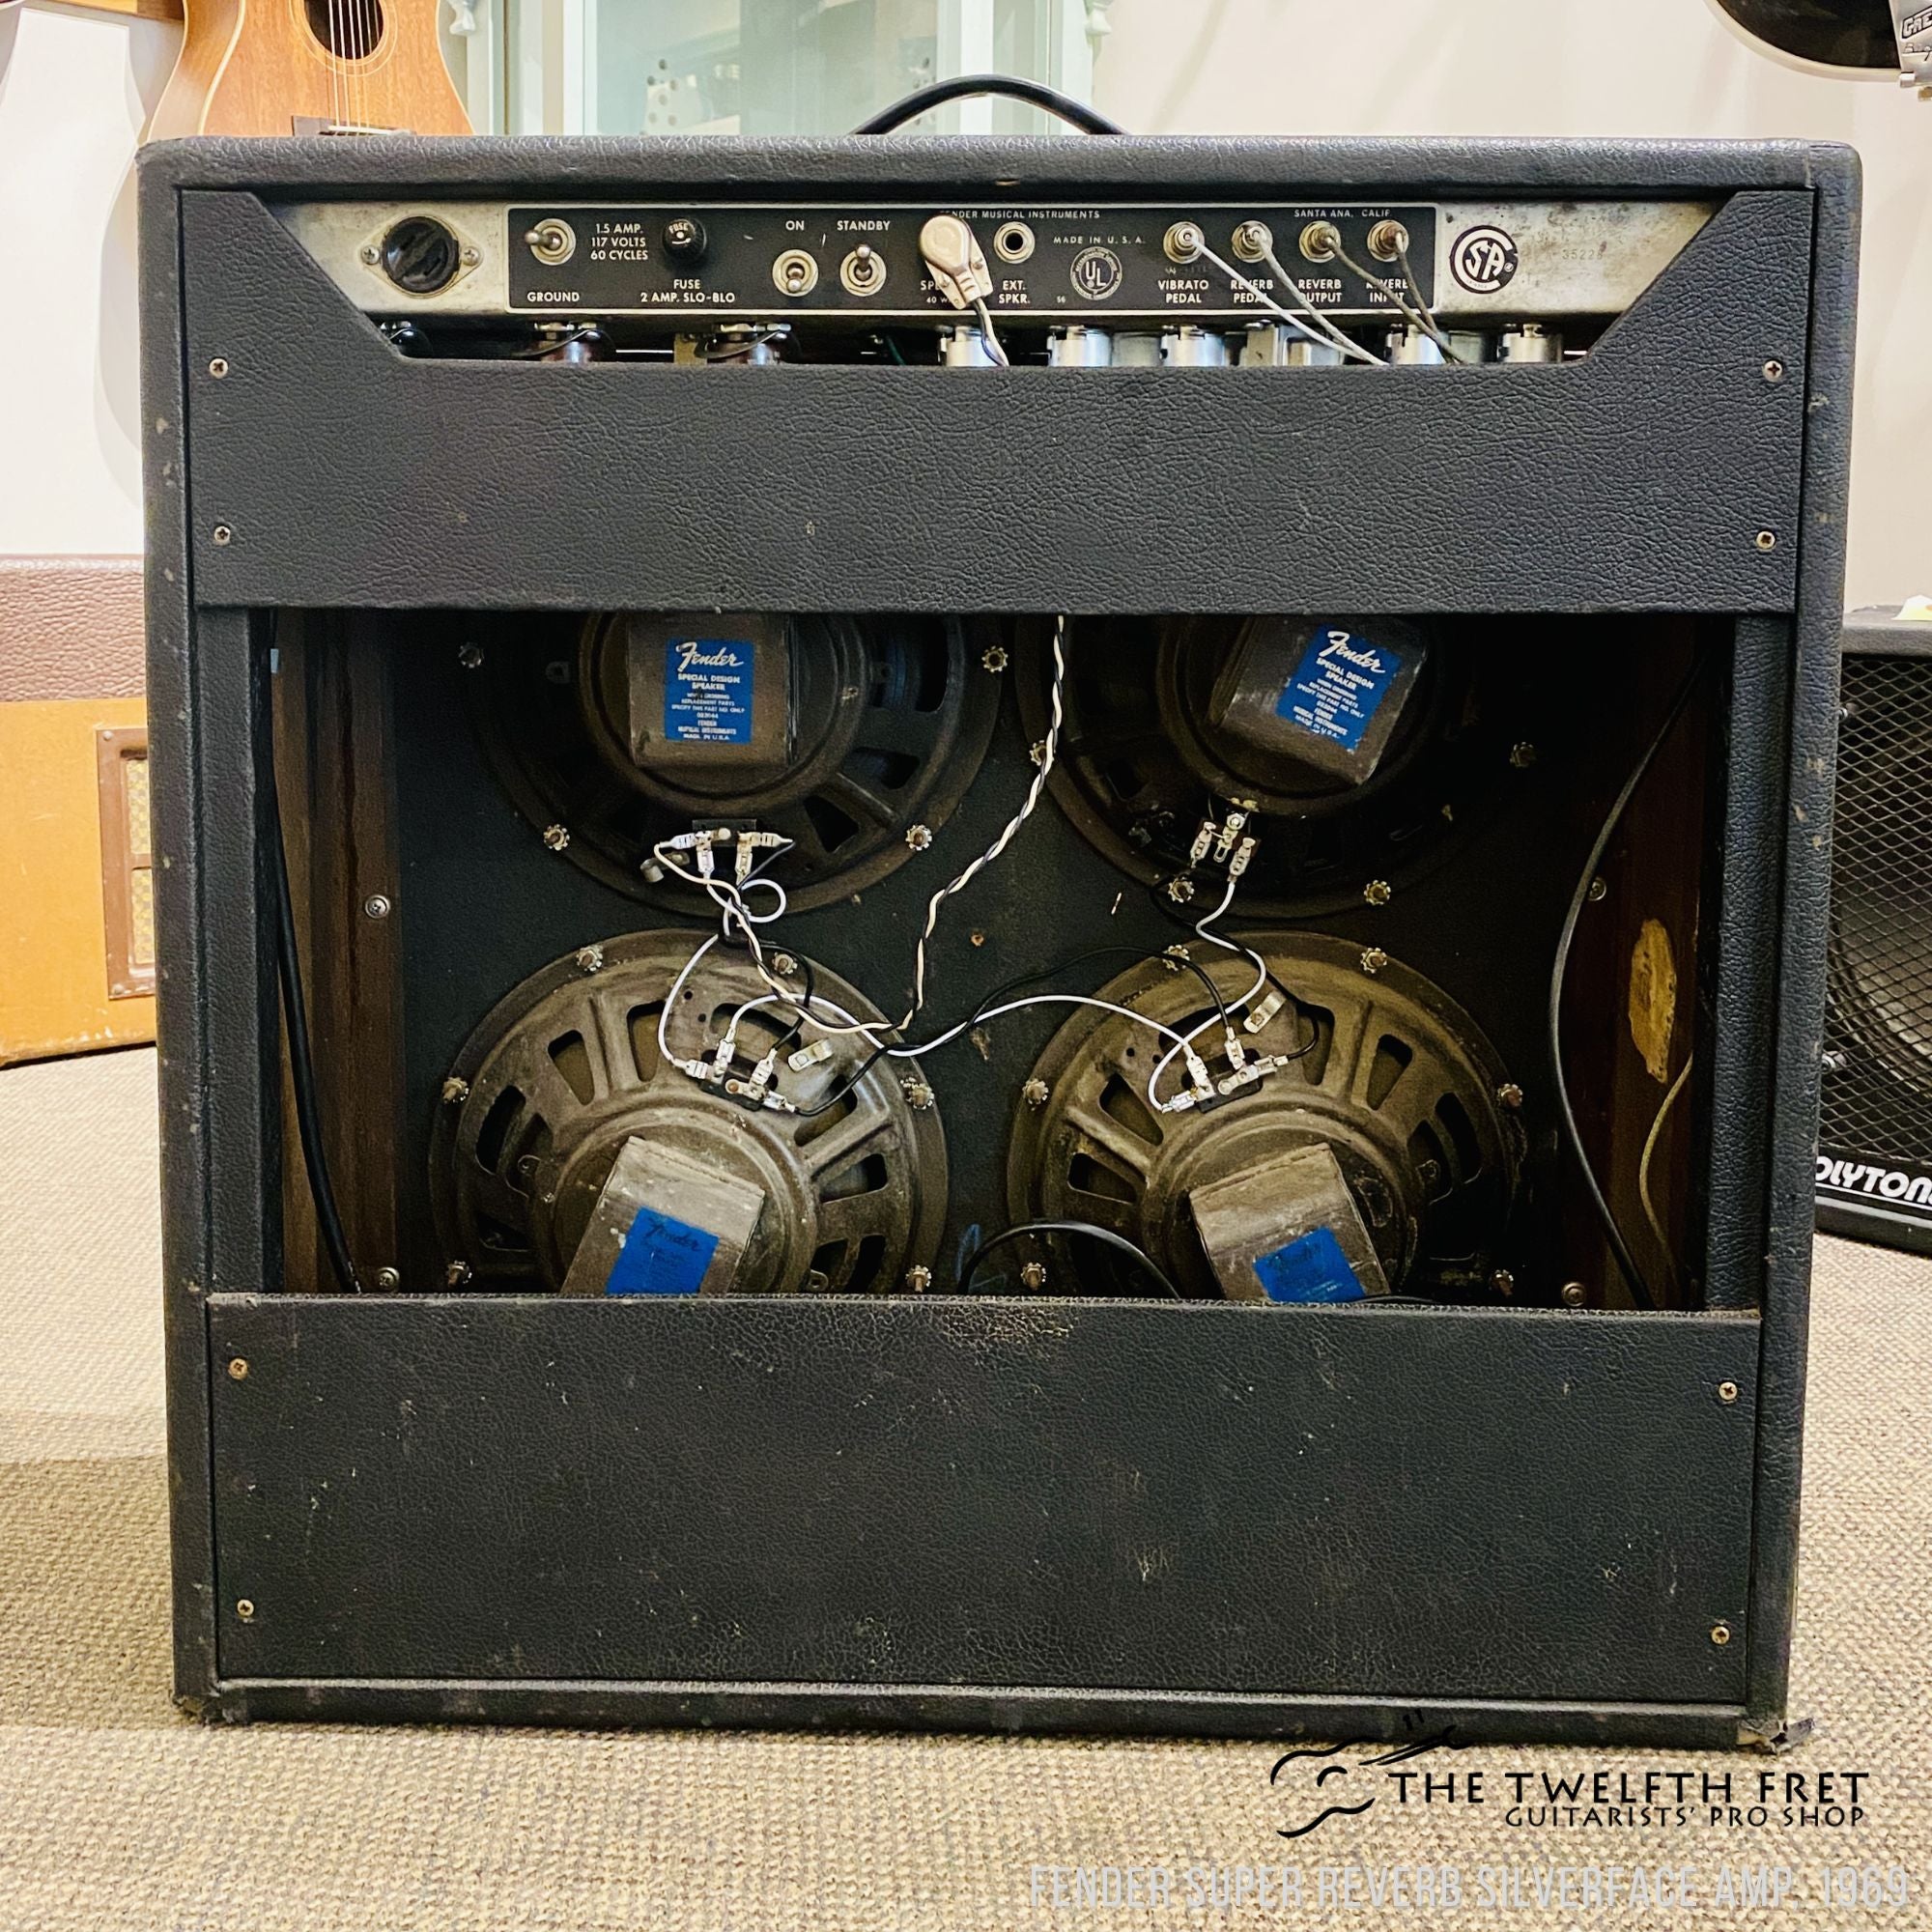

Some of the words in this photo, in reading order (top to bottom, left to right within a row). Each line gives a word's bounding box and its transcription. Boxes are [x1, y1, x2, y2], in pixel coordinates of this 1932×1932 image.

[981, 211, 1025, 219] MUSICAL
[1029, 211, 1100, 219] INSTRUMENTS
[1294, 209, 1326, 218] SANTA
[596, 223, 611, 234] 1.5
[613, 223, 643, 234] AMP.
[668, 222, 690, 234] FUSE
[785, 220, 805, 231] ON
[837, 220, 891, 231] STANDBY
[591, 237, 608, 247] 117
[611, 237, 646, 247] VOLTS
[1053, 236, 1082, 244] MADE
[1089, 236, 1101, 244] IN
[590, 250, 607, 261] 60
[609, 250, 648, 261] CYCLES
[1085, 260, 1107, 287] UL
[673, 279, 700, 290] FUSE
[1002, 280, 1027, 291] EXT.
[1157, 279, 1209, 291] VIBRATO
[1297, 278, 1342, 290] REVERB
[526, 292, 581, 302] GROUND
[640, 293, 648, 303] 2
[651, 293, 680, 303] AMP.
[683, 293, 736, 303] SLO-BLO
[998, 294, 1031, 304] SPKR.
[1165, 293, 1203, 303] PEDAL
[675, 641, 744, 672] Fender
[1319, 631, 1385, 673] Fender
[1316, 657, 1345, 675] SPECIAL
[1346, 671, 1375, 690] DESIGN
[1325, 670, 1357, 691] SPEAKER
[692, 682, 725, 691] SPEAKER
